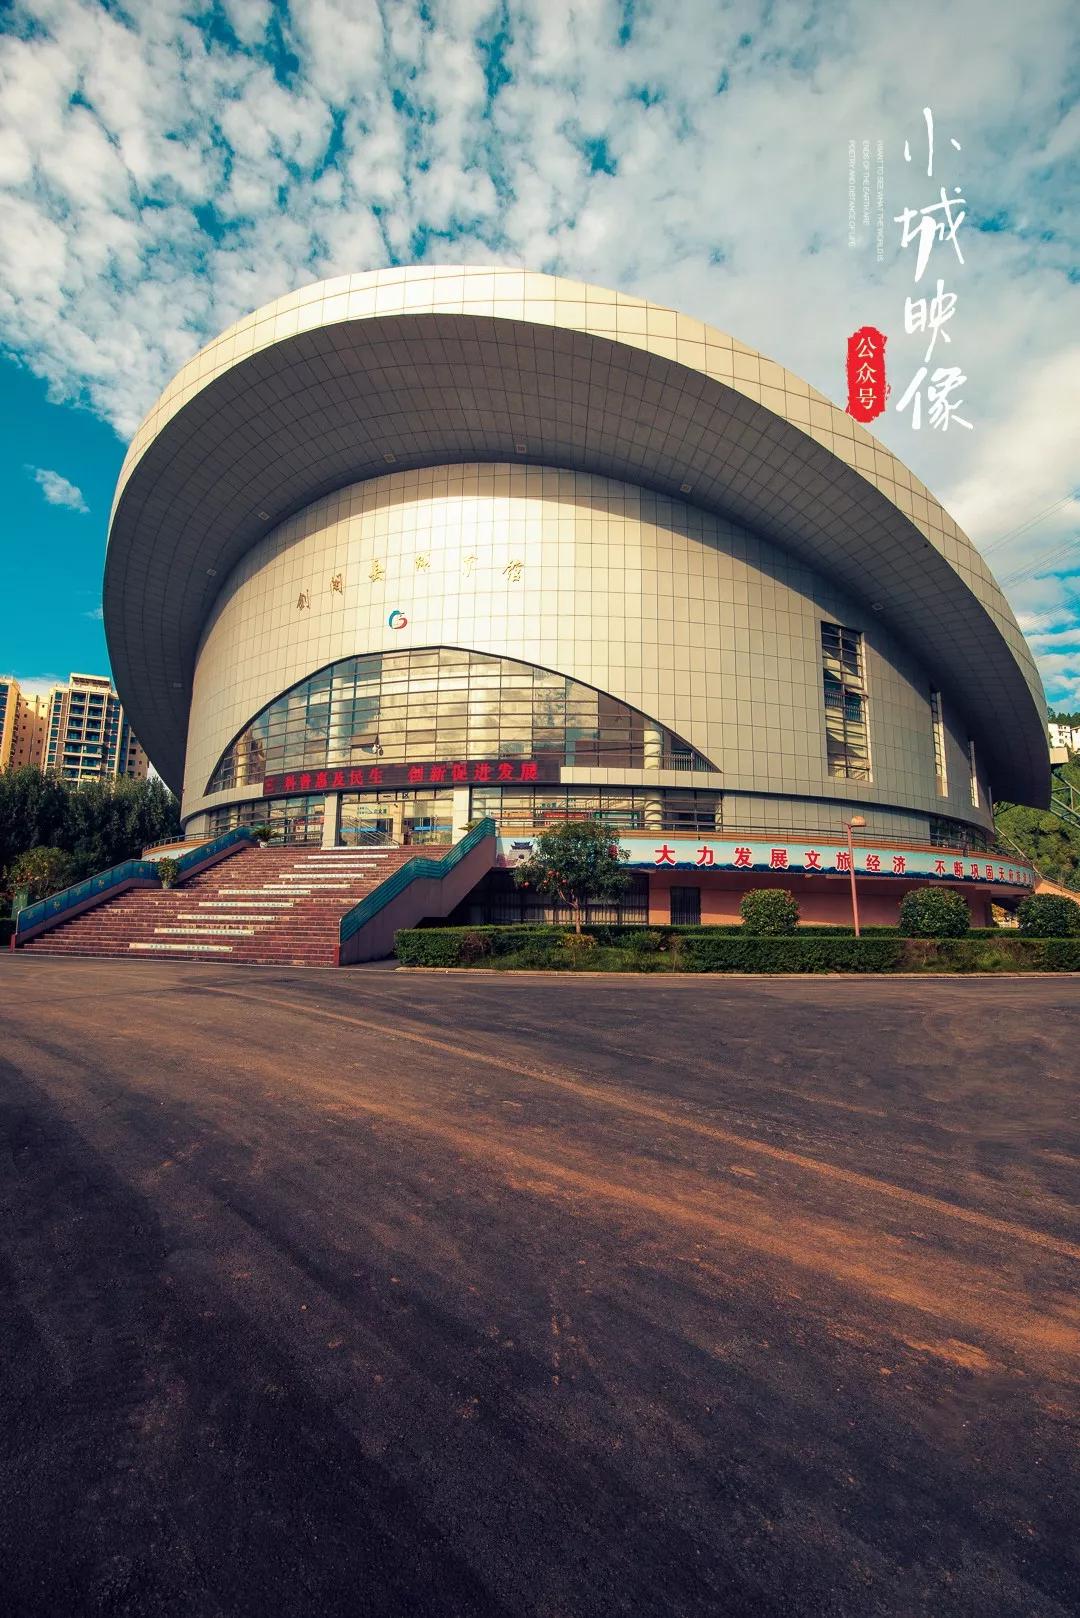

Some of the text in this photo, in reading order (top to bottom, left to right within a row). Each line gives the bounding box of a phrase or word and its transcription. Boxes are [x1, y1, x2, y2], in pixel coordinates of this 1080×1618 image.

[407, 761, 538, 782] 创新促进发展
[654, 843, 907, 875] 大力发展文旅经济
